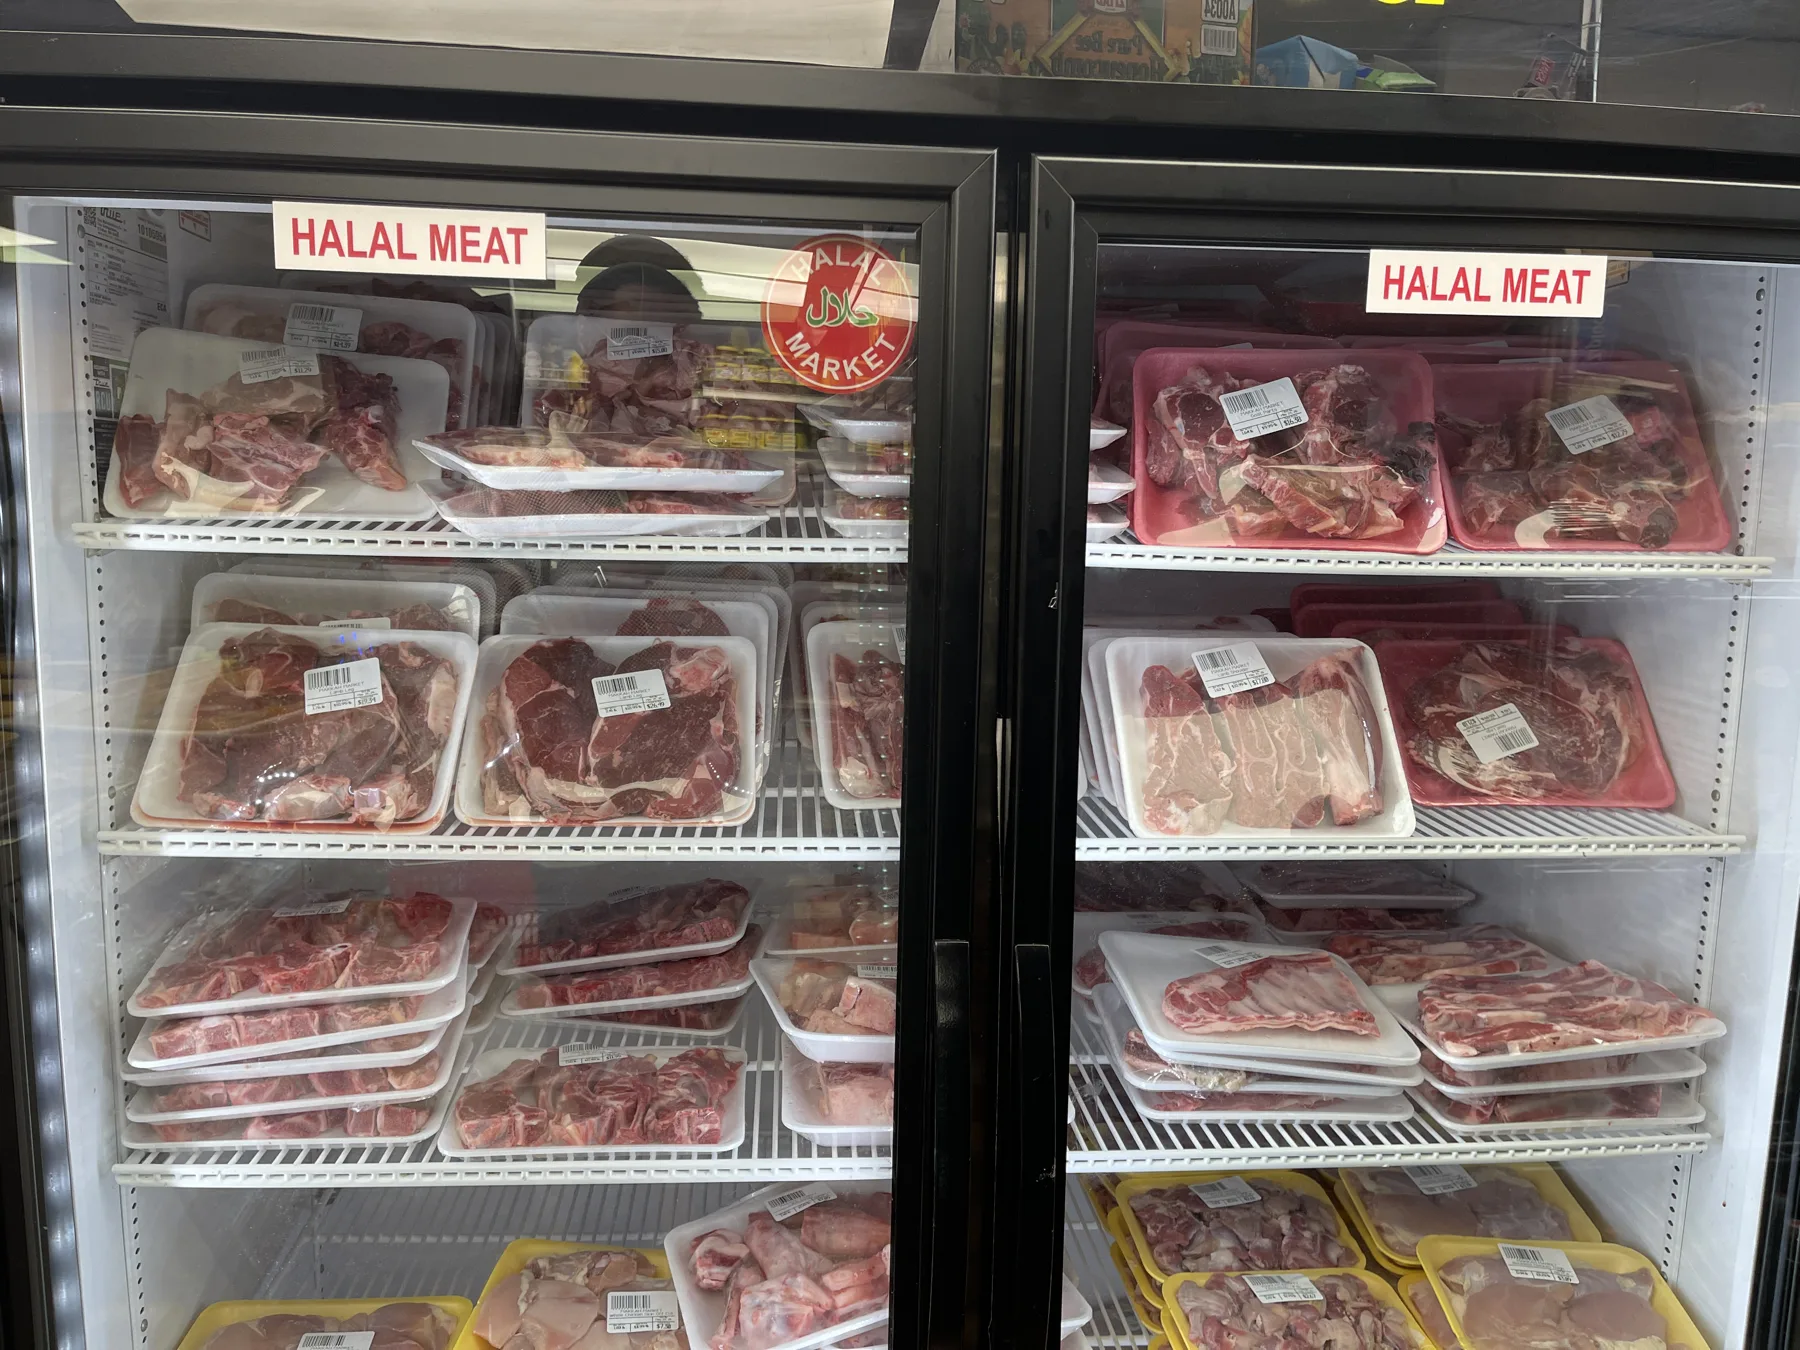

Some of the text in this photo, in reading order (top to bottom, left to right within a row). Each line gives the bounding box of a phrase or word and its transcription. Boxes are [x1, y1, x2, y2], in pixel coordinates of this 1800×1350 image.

[292, 218, 528, 264] HALAL MEAT
[790, 244, 886, 287] HALAL
[1384, 265, 1491, 302] HALAL
[1502, 268, 1591, 304] MEAT
[806, 286, 879, 328] حلال
[785, 332, 896, 381] MARKET
